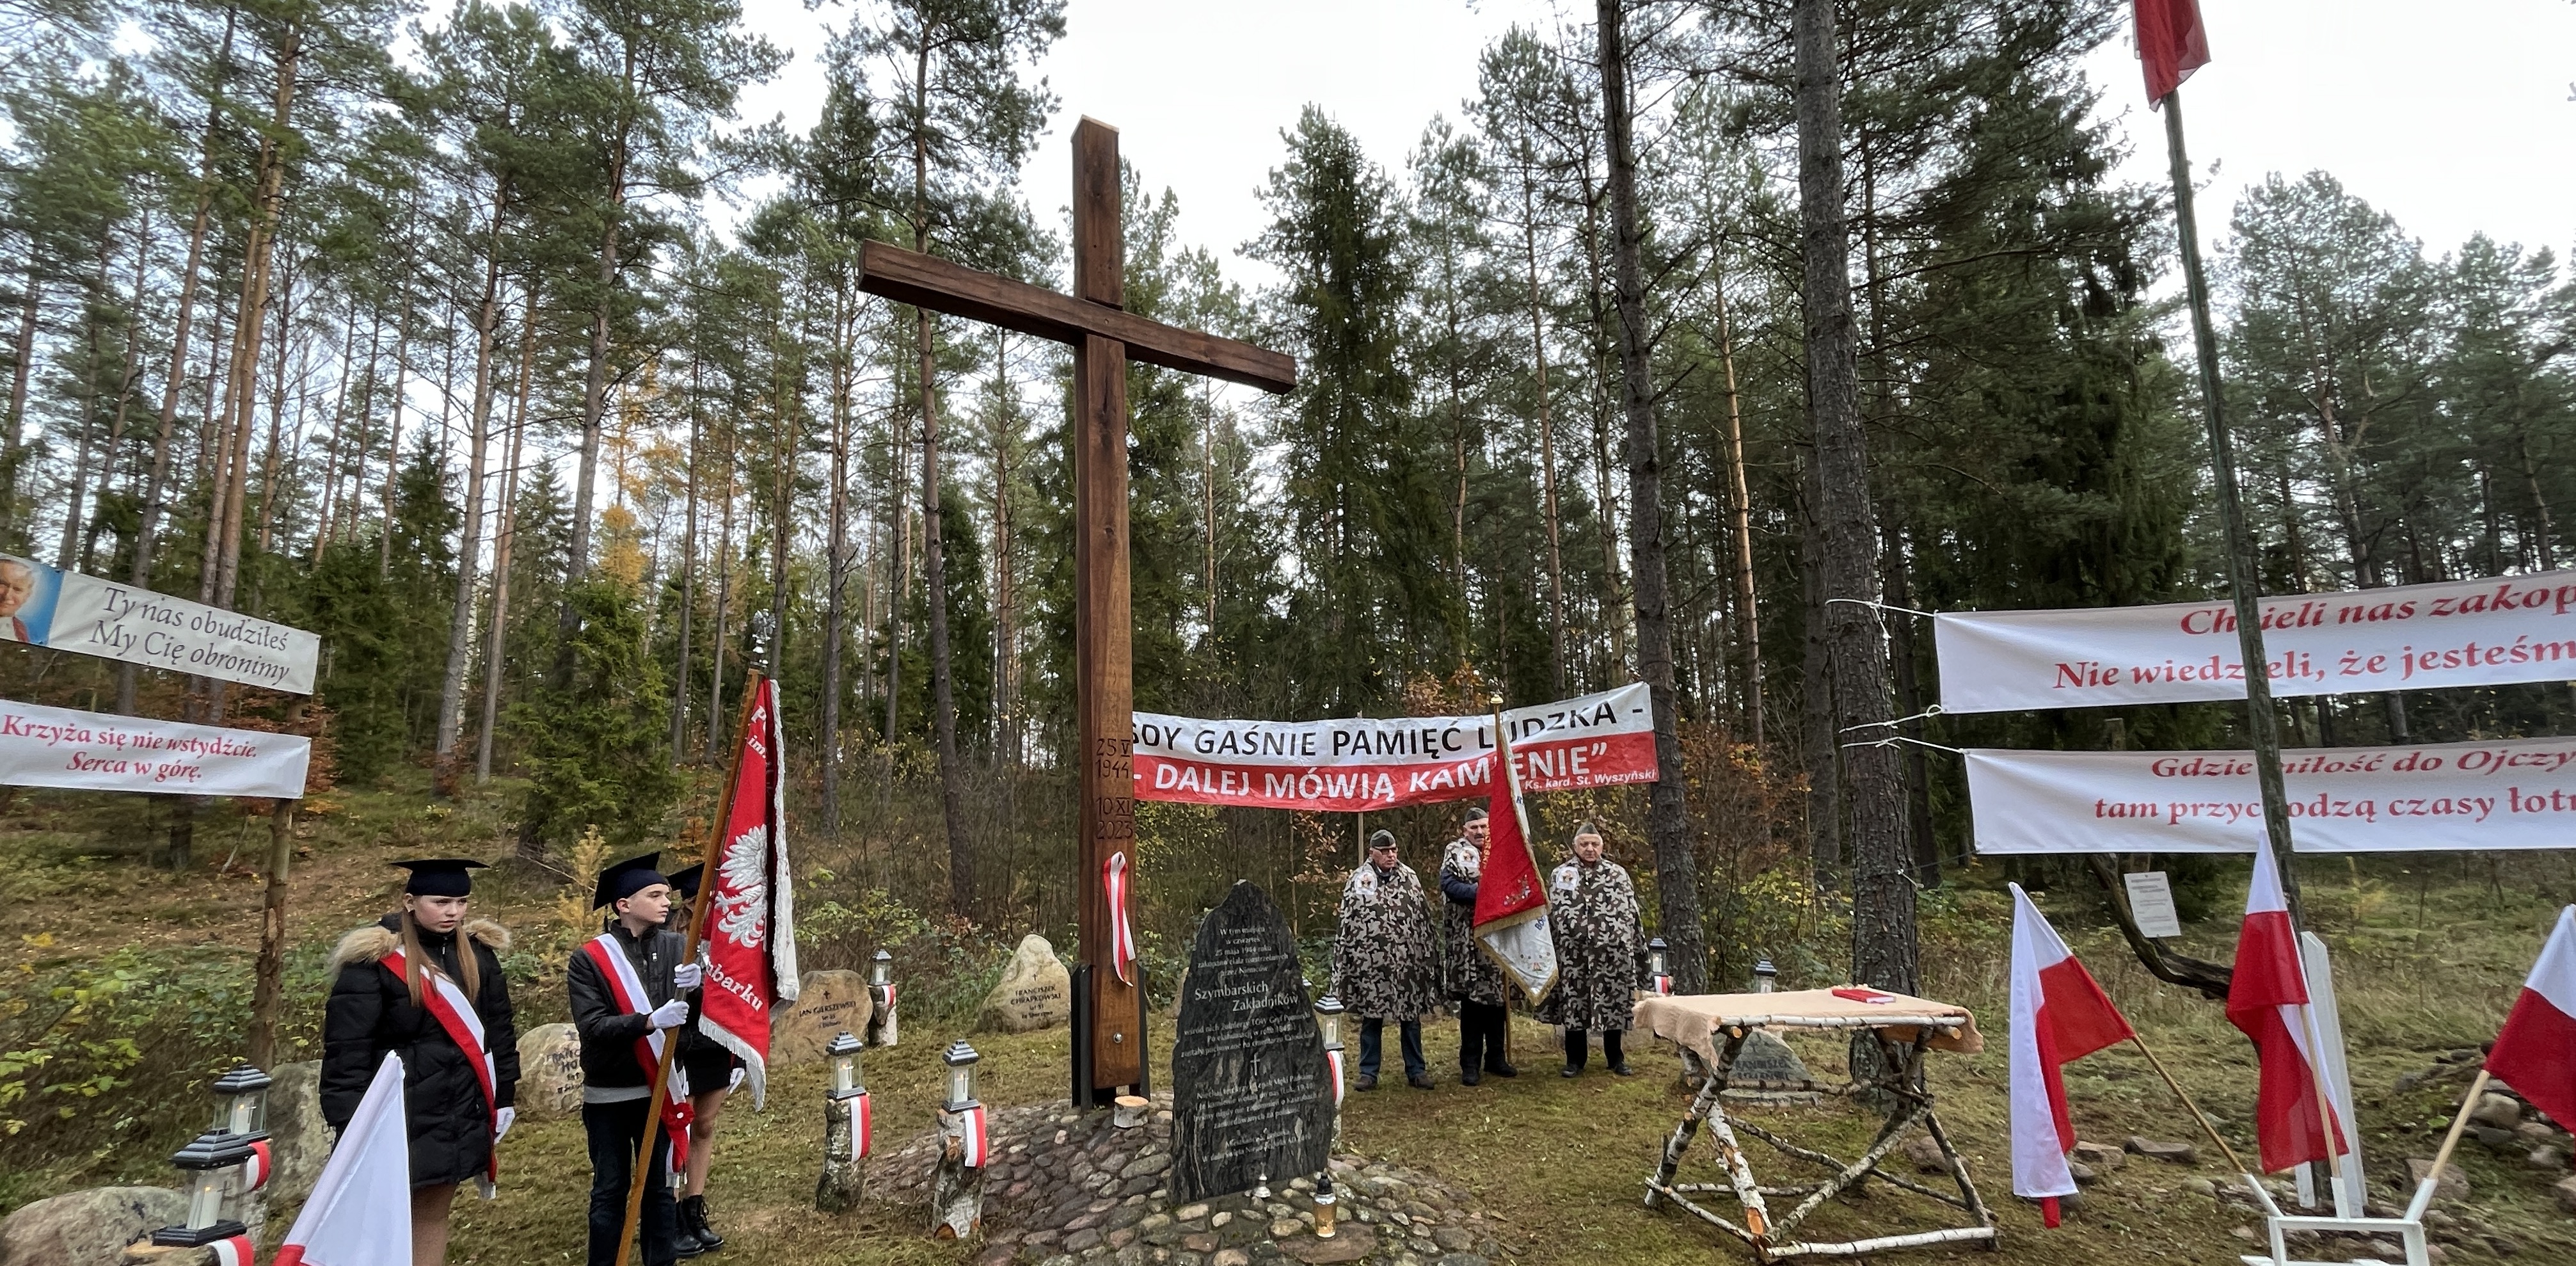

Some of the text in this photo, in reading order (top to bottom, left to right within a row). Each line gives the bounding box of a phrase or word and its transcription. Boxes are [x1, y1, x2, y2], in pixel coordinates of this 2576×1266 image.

[103, 587, 289, 651] Ty nas obudziłeś
[2181, 584, 2576, 635] Chieli nas zakop
[89, 620, 290, 686] My Cię obronimy
[2053, 662, 2120, 689] Nie
[2131, 650, 2325, 685] wiedzeli,
[2339, 650, 2387, 675] że
[751, 705, 767, 733] P
[1, 714, 257, 760] Krzyża się nie wstydźcie.
[1096, 739, 1117, 757] 25
[1195, 725, 1316, 756] GAŚNIE
[1333, 721, 1461, 759] PAMIĘĆ
[66, 751, 202, 783] Serca w górę.
[1095, 760, 1129, 778] 1944
[1155, 763, 1249, 796] DALEJ
[1265, 767, 1395, 803] MÓWIĄ
[1410, 742, 1607, 792] KAMENIE”
[2151, 757, 2254, 777] Gdzie
[2392, 751, 2443, 772] do
[2457, 749, 2576, 776] Ojczy
[1525, 769, 1655, 790] Ks. kard. St. Wyszyński
[1095, 797, 1131, 816] 10 XI
[2095, 799, 2159, 819] tam
[2167, 792, 2377, 825] przycodzą
[2389, 797, 2495, 823] czasy
[1095, 821, 1133, 840] 2023
[1195, 980, 1269, 1002] Szymbarskich
[1232, 991, 1299, 1012] Zakładników
